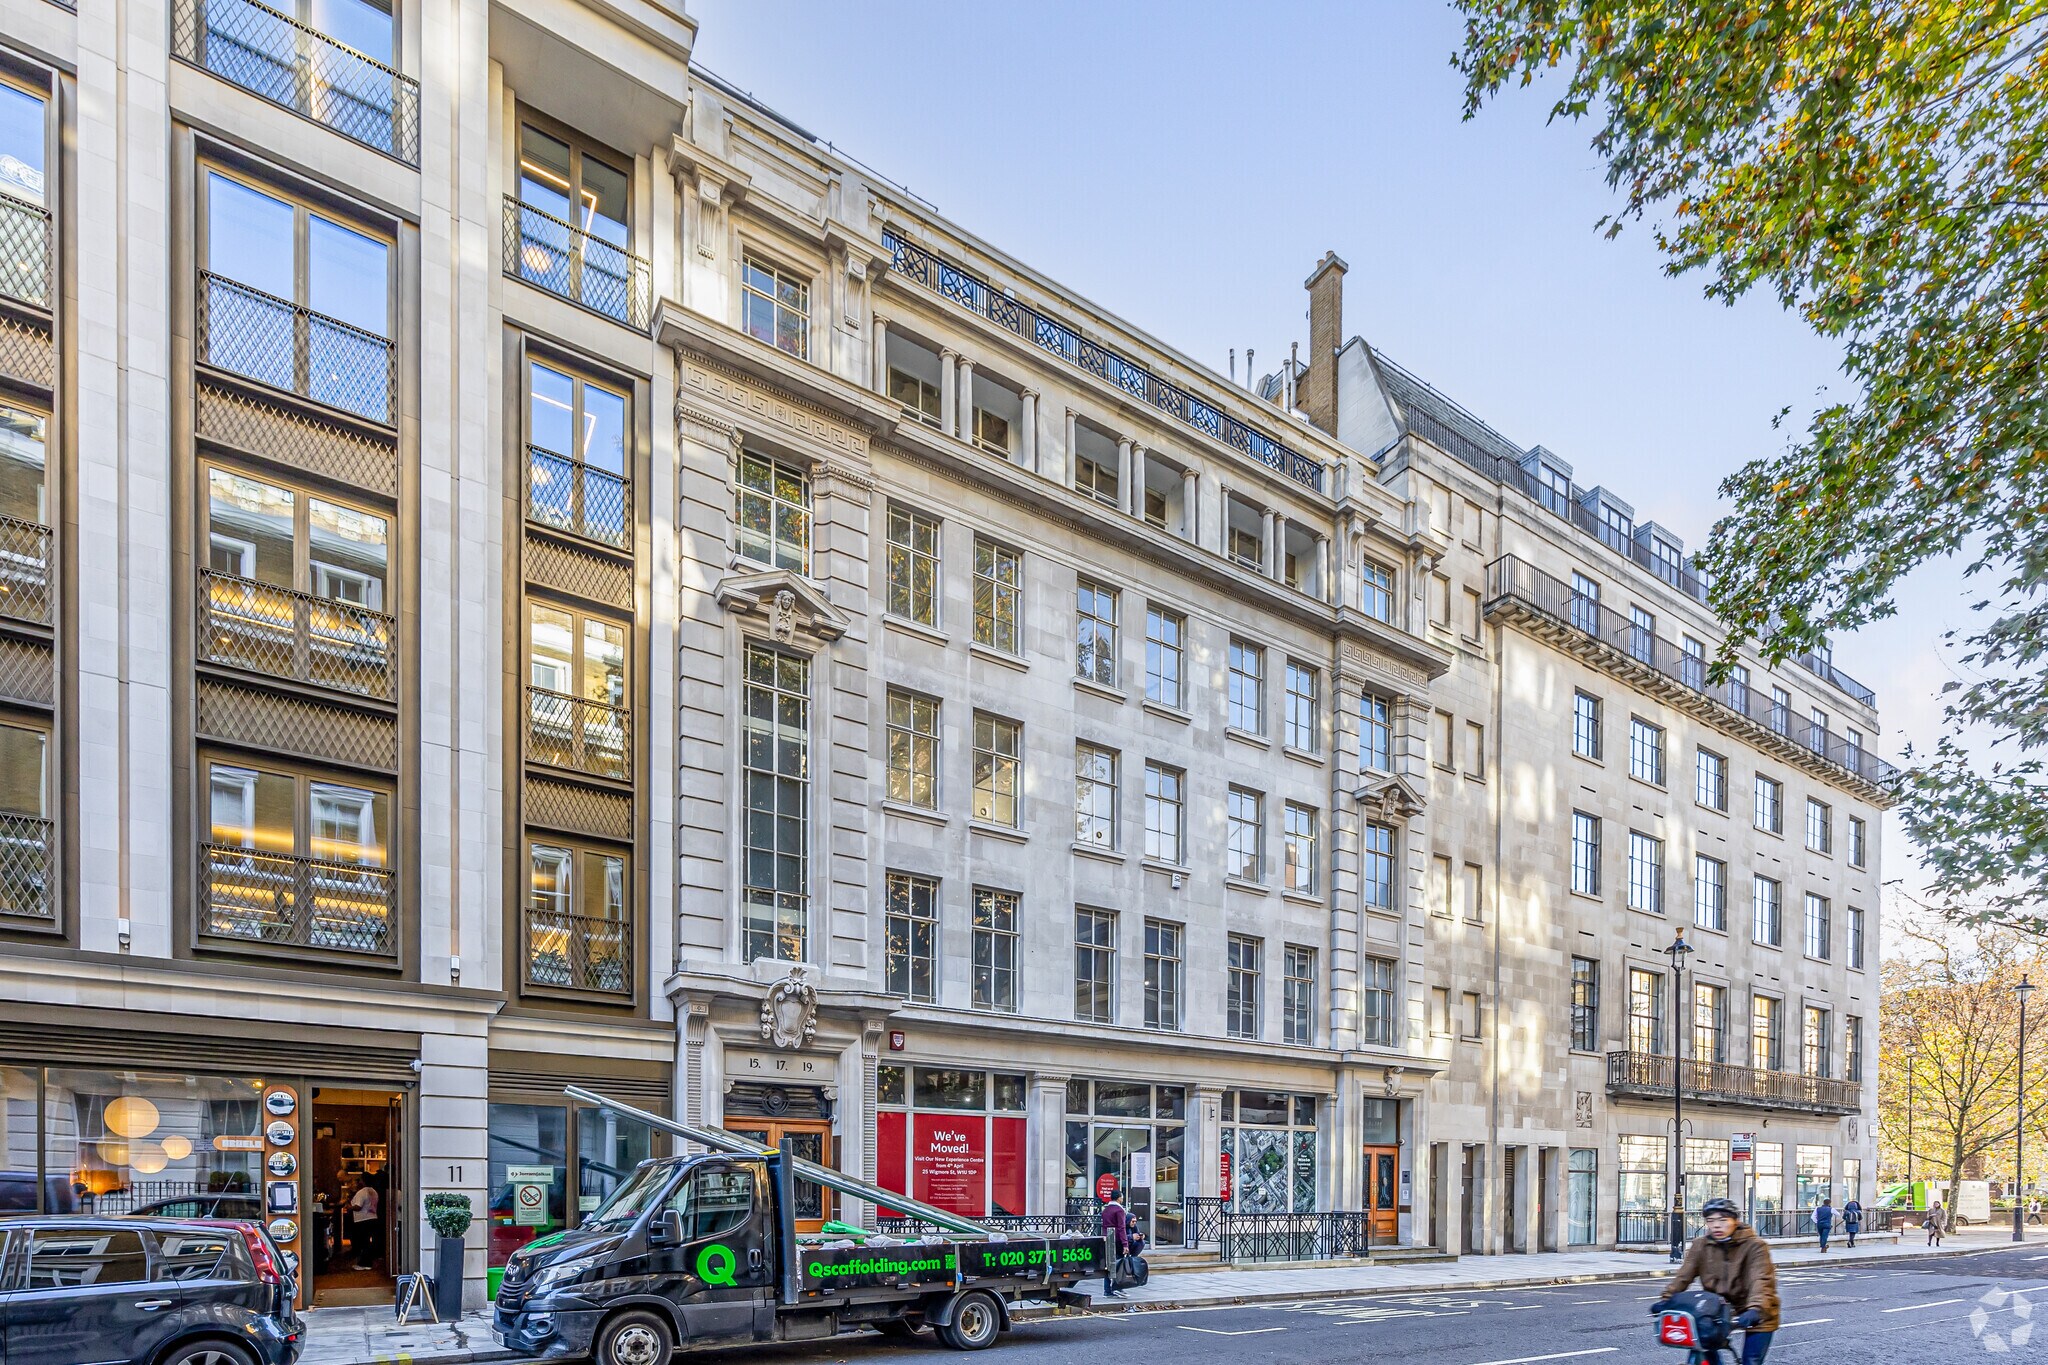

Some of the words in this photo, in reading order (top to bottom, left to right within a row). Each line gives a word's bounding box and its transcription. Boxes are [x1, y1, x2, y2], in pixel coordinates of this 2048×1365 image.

[749, 1058, 761, 1069] 15.
[776, 1060, 788, 1071] 17.
[803, 1062, 814, 1073] 19.
[934, 1130, 966, 1142] We’ve
[930, 1143, 969, 1153] Moved!
[448, 1165, 462, 1183] 11
[696, 1244, 738, 1286] Q
[809, 1258, 941, 1278] Qscaffolding.com
[983, 1252, 996, 1267] T:
[1000, 1251, 1025, 1266] 020
[1062, 1247, 1092, 1262] 5636
